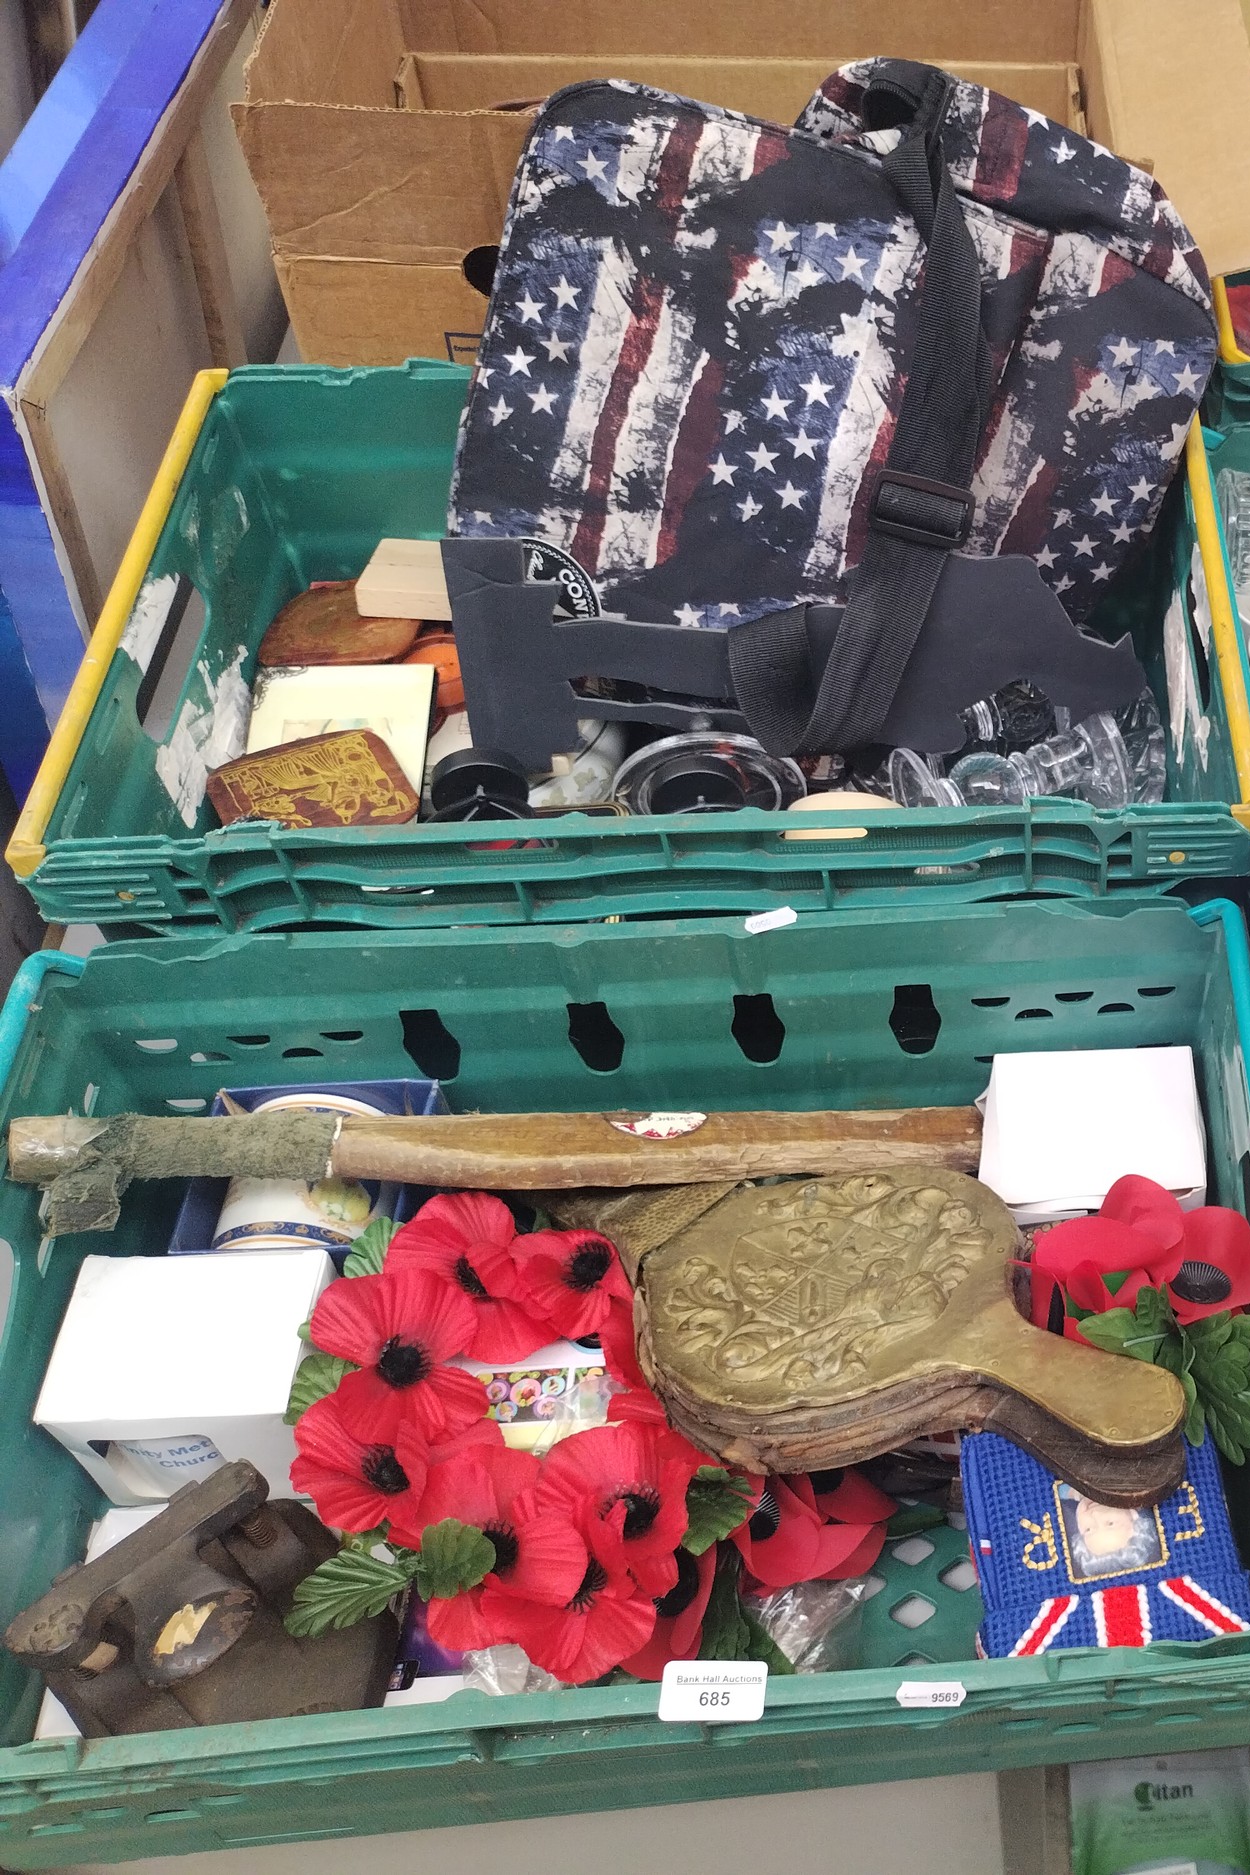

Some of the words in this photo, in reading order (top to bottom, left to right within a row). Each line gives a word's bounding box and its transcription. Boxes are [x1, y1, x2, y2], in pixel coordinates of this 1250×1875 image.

[167, 1440, 211, 1457] Met
[159, 1450, 220, 1468] Churc
[677, 1675, 700, 1684] Bank
[702, 1675, 720, 1683] Hall
[722, 1675, 763, 1683] Auctions
[699, 1691, 731, 1706] 685
[931, 1692, 959, 1703] 9569
